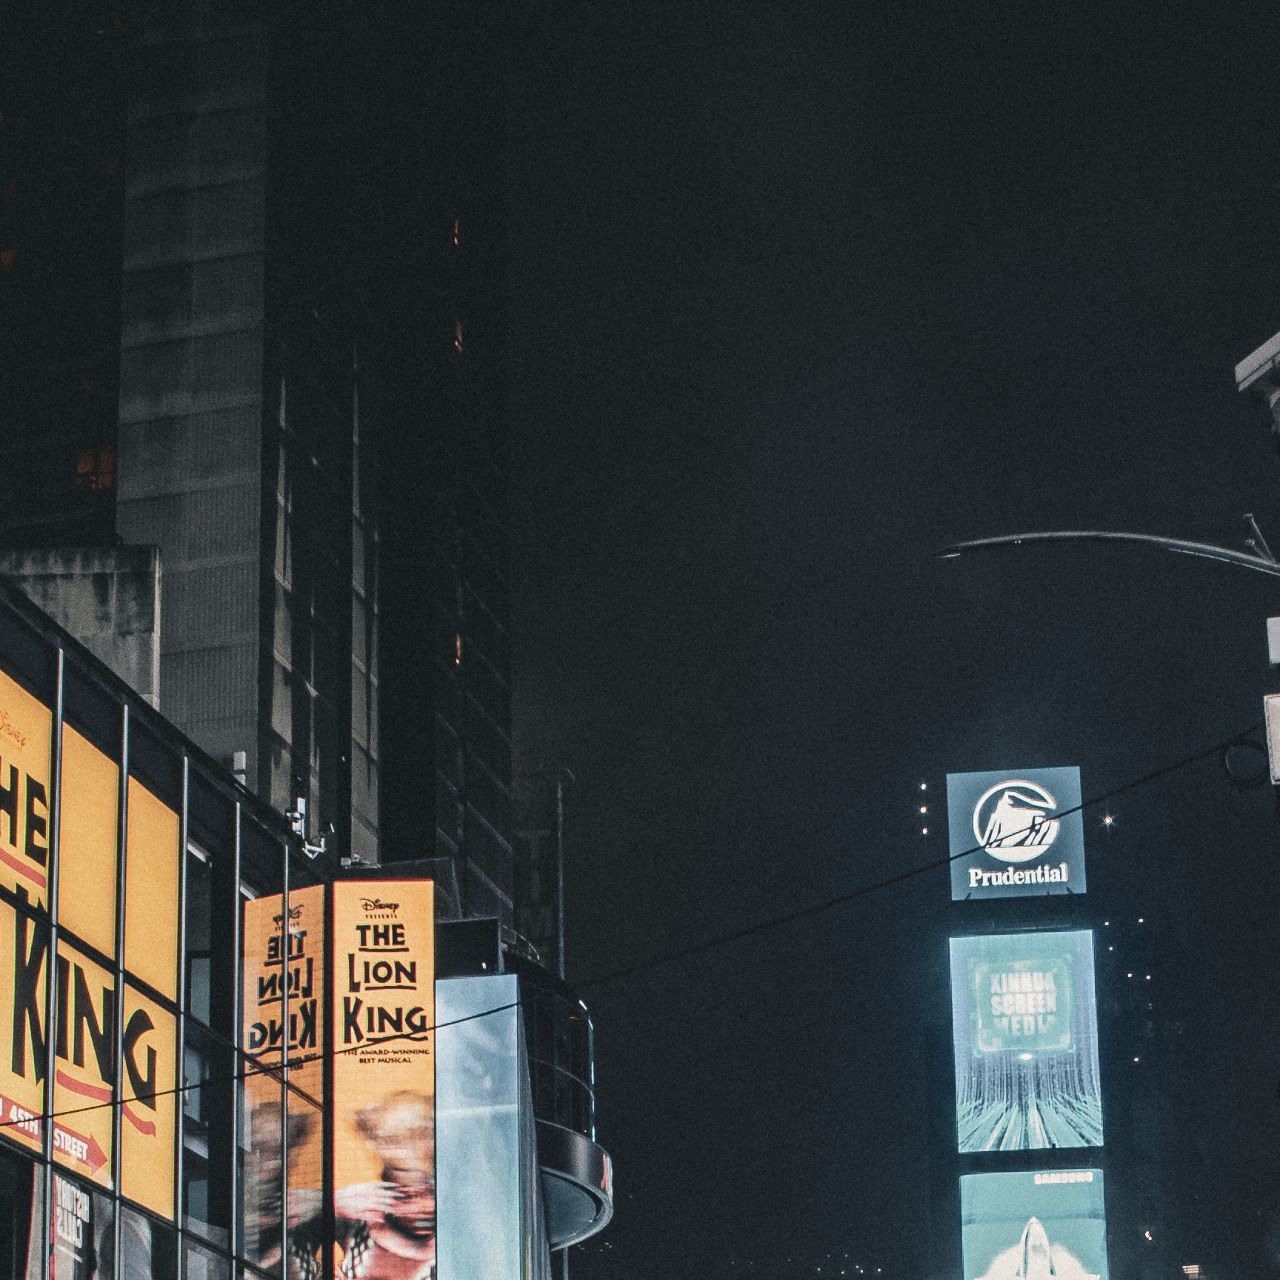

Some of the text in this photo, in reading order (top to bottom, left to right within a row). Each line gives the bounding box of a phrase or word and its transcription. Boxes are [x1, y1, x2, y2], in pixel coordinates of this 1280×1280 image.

[968, 862, 1069, 888] Prudential
[360, 898, 400, 914] Disney
[356, 924, 406, 946] THE
[348, 953, 417, 992] LION
[11, 883, 157, 1112] KING
[343, 996, 427, 1043] KING
[9, 1105, 41, 1136] 45TH
[53, 1123, 89, 1162] STREET
